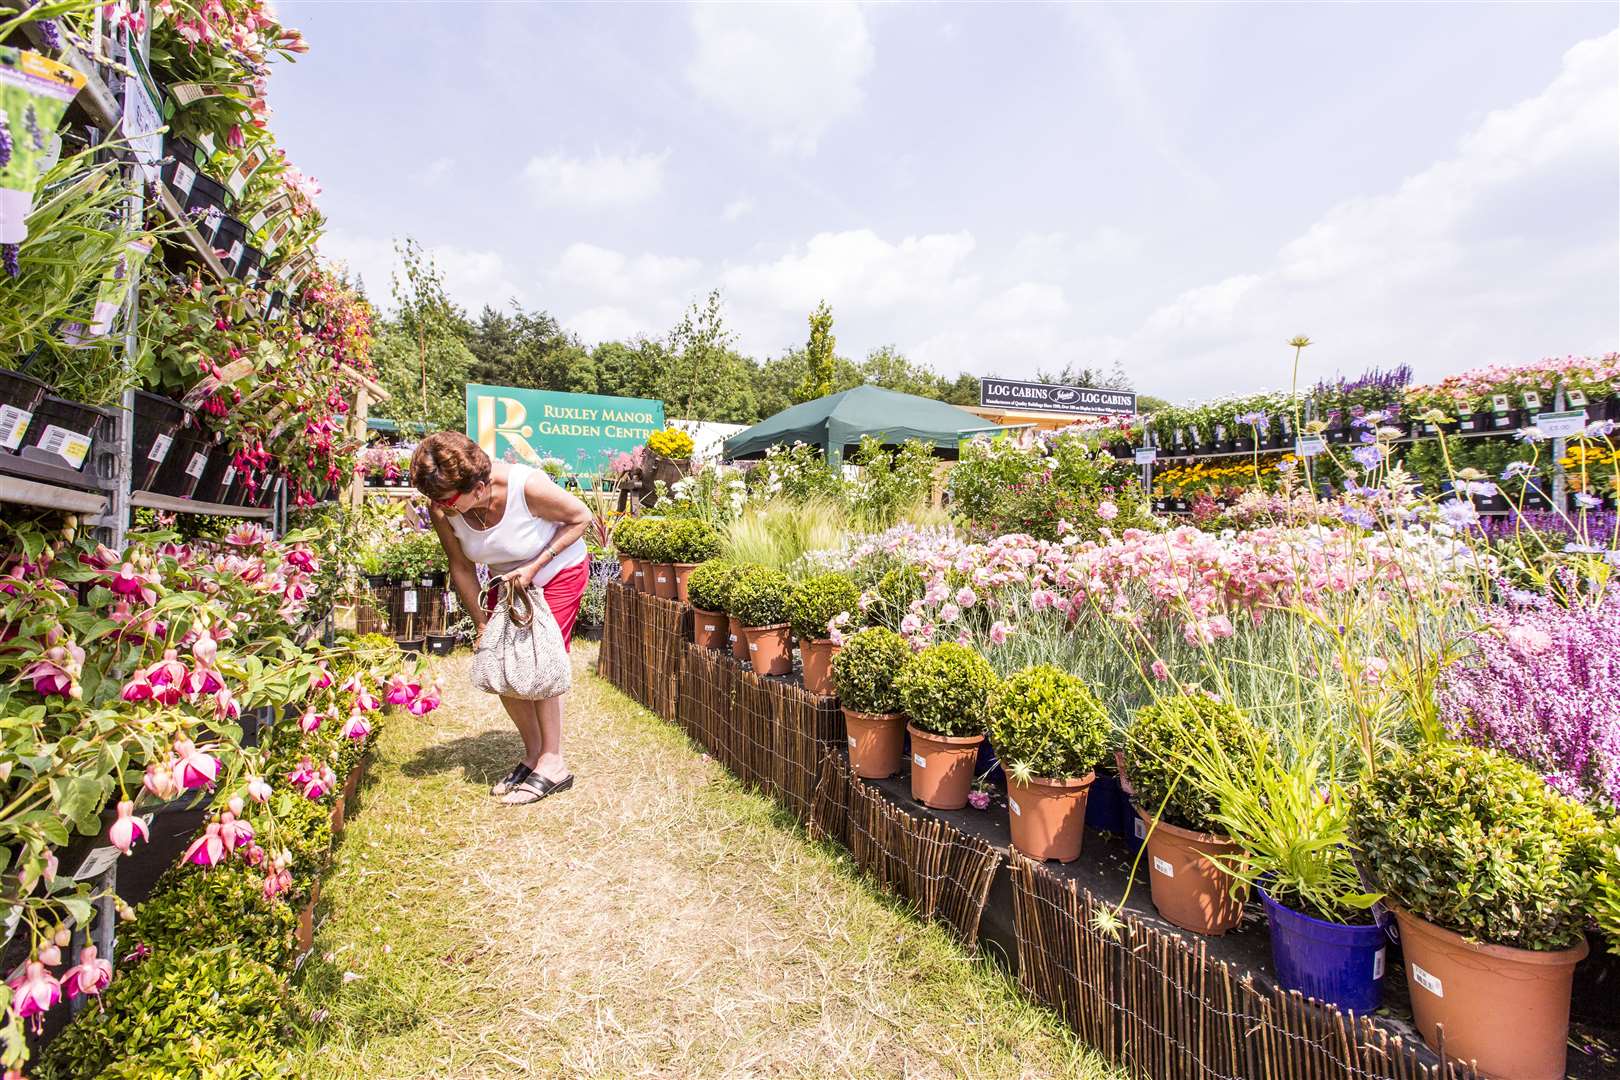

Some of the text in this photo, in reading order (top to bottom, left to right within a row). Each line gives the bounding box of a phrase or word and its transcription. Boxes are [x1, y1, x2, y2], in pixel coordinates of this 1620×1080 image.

[988, 384, 1010, 396] LOG
[1012, 387, 1048, 399] CABINS
[1081, 393, 1100, 404] LOG
[1101, 395, 1132, 406] CABINS
[543, 404, 654, 425] RUXLEY MANOR
[538, 421, 601, 438] GARDEN
